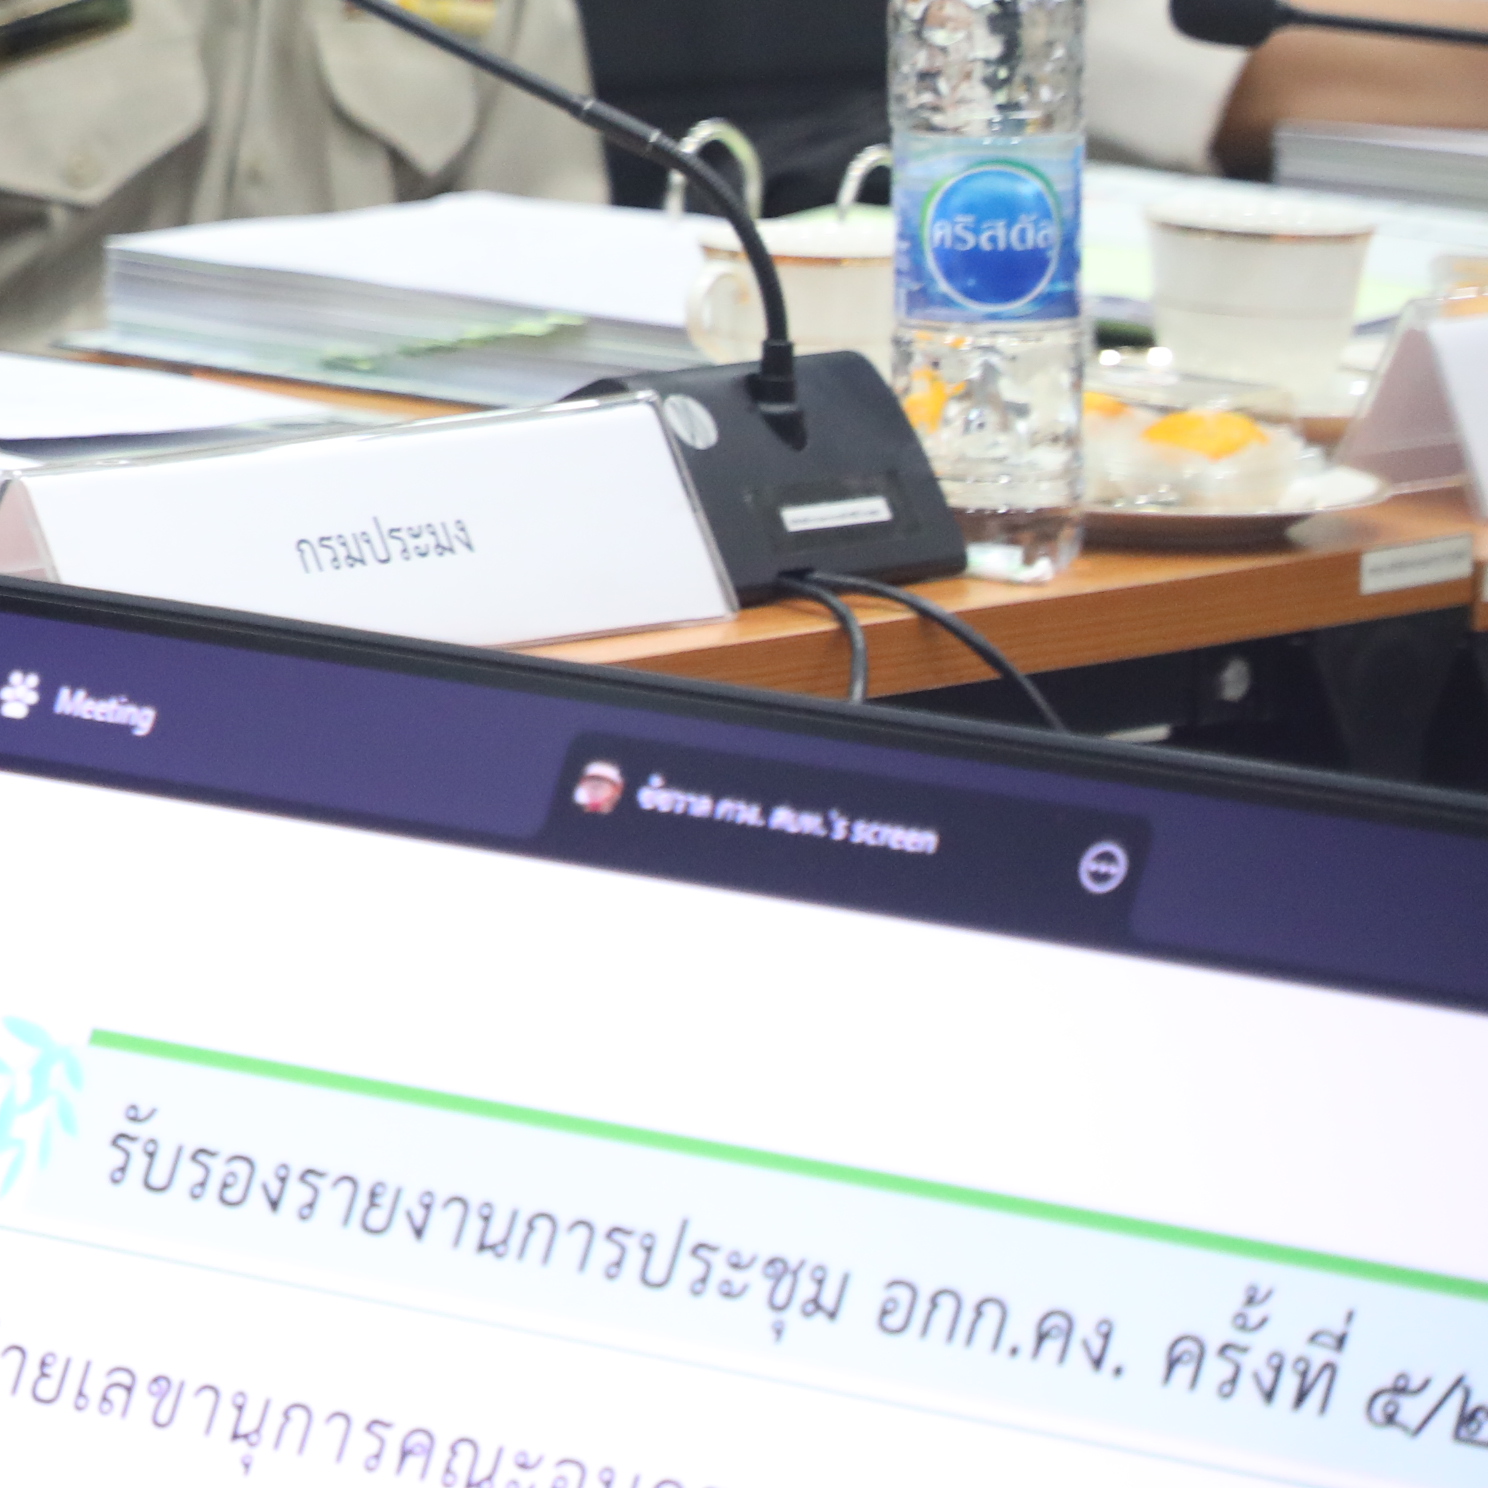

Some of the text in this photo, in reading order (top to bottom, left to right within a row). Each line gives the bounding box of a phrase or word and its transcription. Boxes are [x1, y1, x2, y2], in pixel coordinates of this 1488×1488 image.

[295, 515, 475, 574] กรมประมง
[52, 684, 158, 737] Meeting
[109, 1104, 850, 1343] รับรองรายงานการประชุม
[877, 1279, 1124, 1379] อกก.คง.
[1162, 1283, 1356, 1416] ครั้งที่
